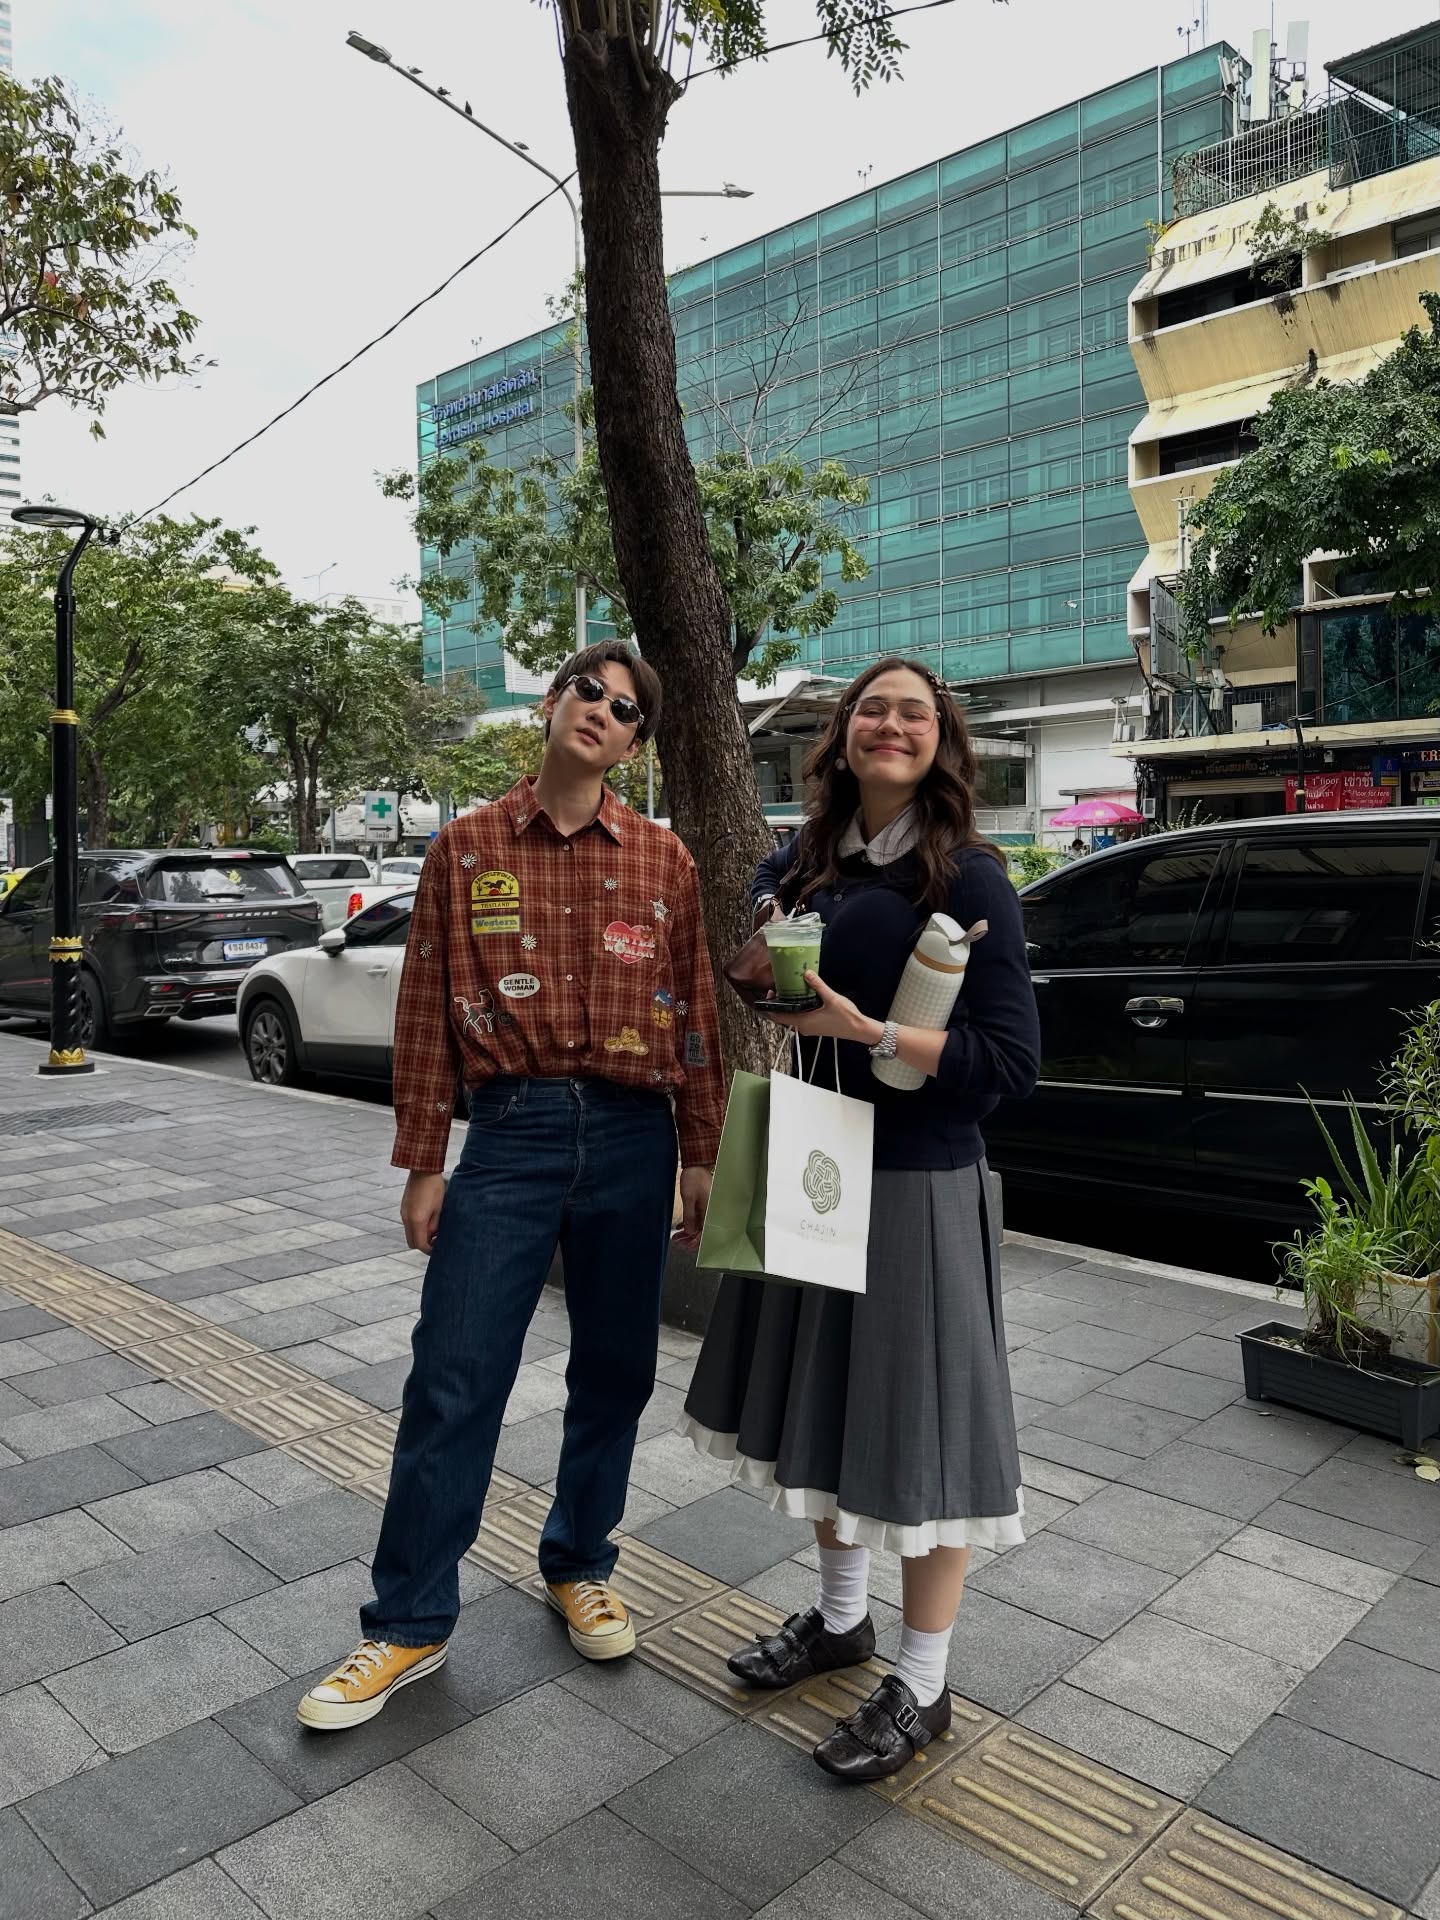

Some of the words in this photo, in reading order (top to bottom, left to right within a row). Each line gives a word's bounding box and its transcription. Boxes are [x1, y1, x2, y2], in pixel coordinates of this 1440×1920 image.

[481, 397, 534, 430] Hospital
[1320, 777, 1339, 786] floor
[475, 918, 518, 928] Western
[603, 941, 655, 959] WMAN
[503, 977, 535, 986] GENTLE
[503, 984, 535, 992] WOMAN
[800, 1219, 836, 1238] CHAJIN
